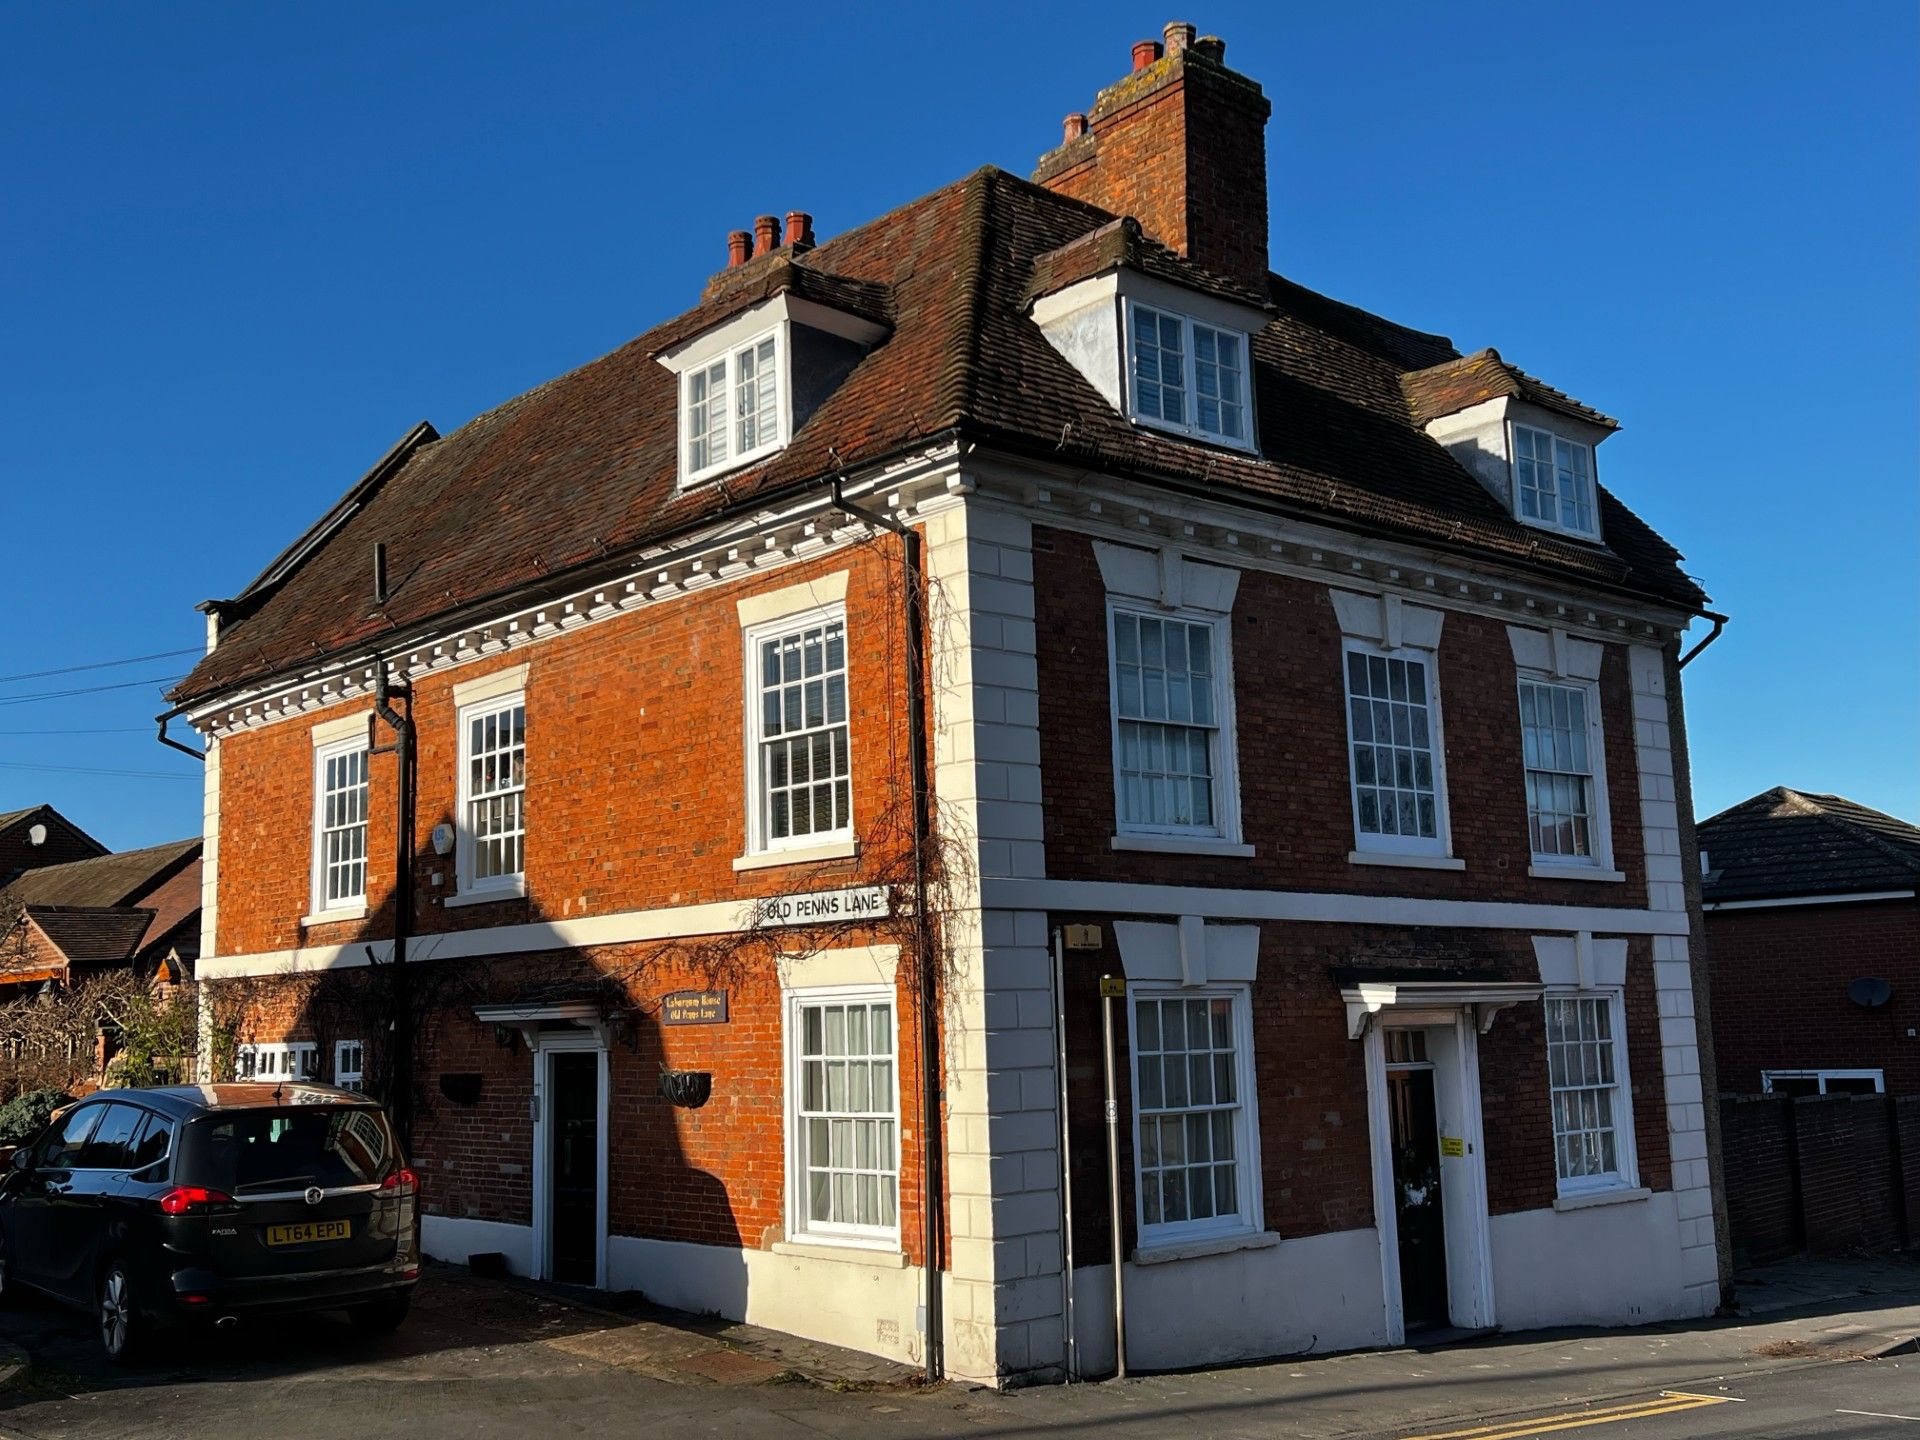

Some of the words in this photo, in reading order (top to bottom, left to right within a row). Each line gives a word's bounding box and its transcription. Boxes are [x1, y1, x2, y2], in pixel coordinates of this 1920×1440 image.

[767, 902, 791, 919] OLD
[797, 898, 839, 916] PENNS
[845, 893, 879, 912] LANE
[701, 994, 721, 1006] House
[670, 1009, 681, 1020] Old
[682, 1009, 700, 1020] Penns
[700, 1007, 716, 1019] Lane
[273, 1226, 312, 1242] LT64
[316, 1222, 345, 1238] EPD
